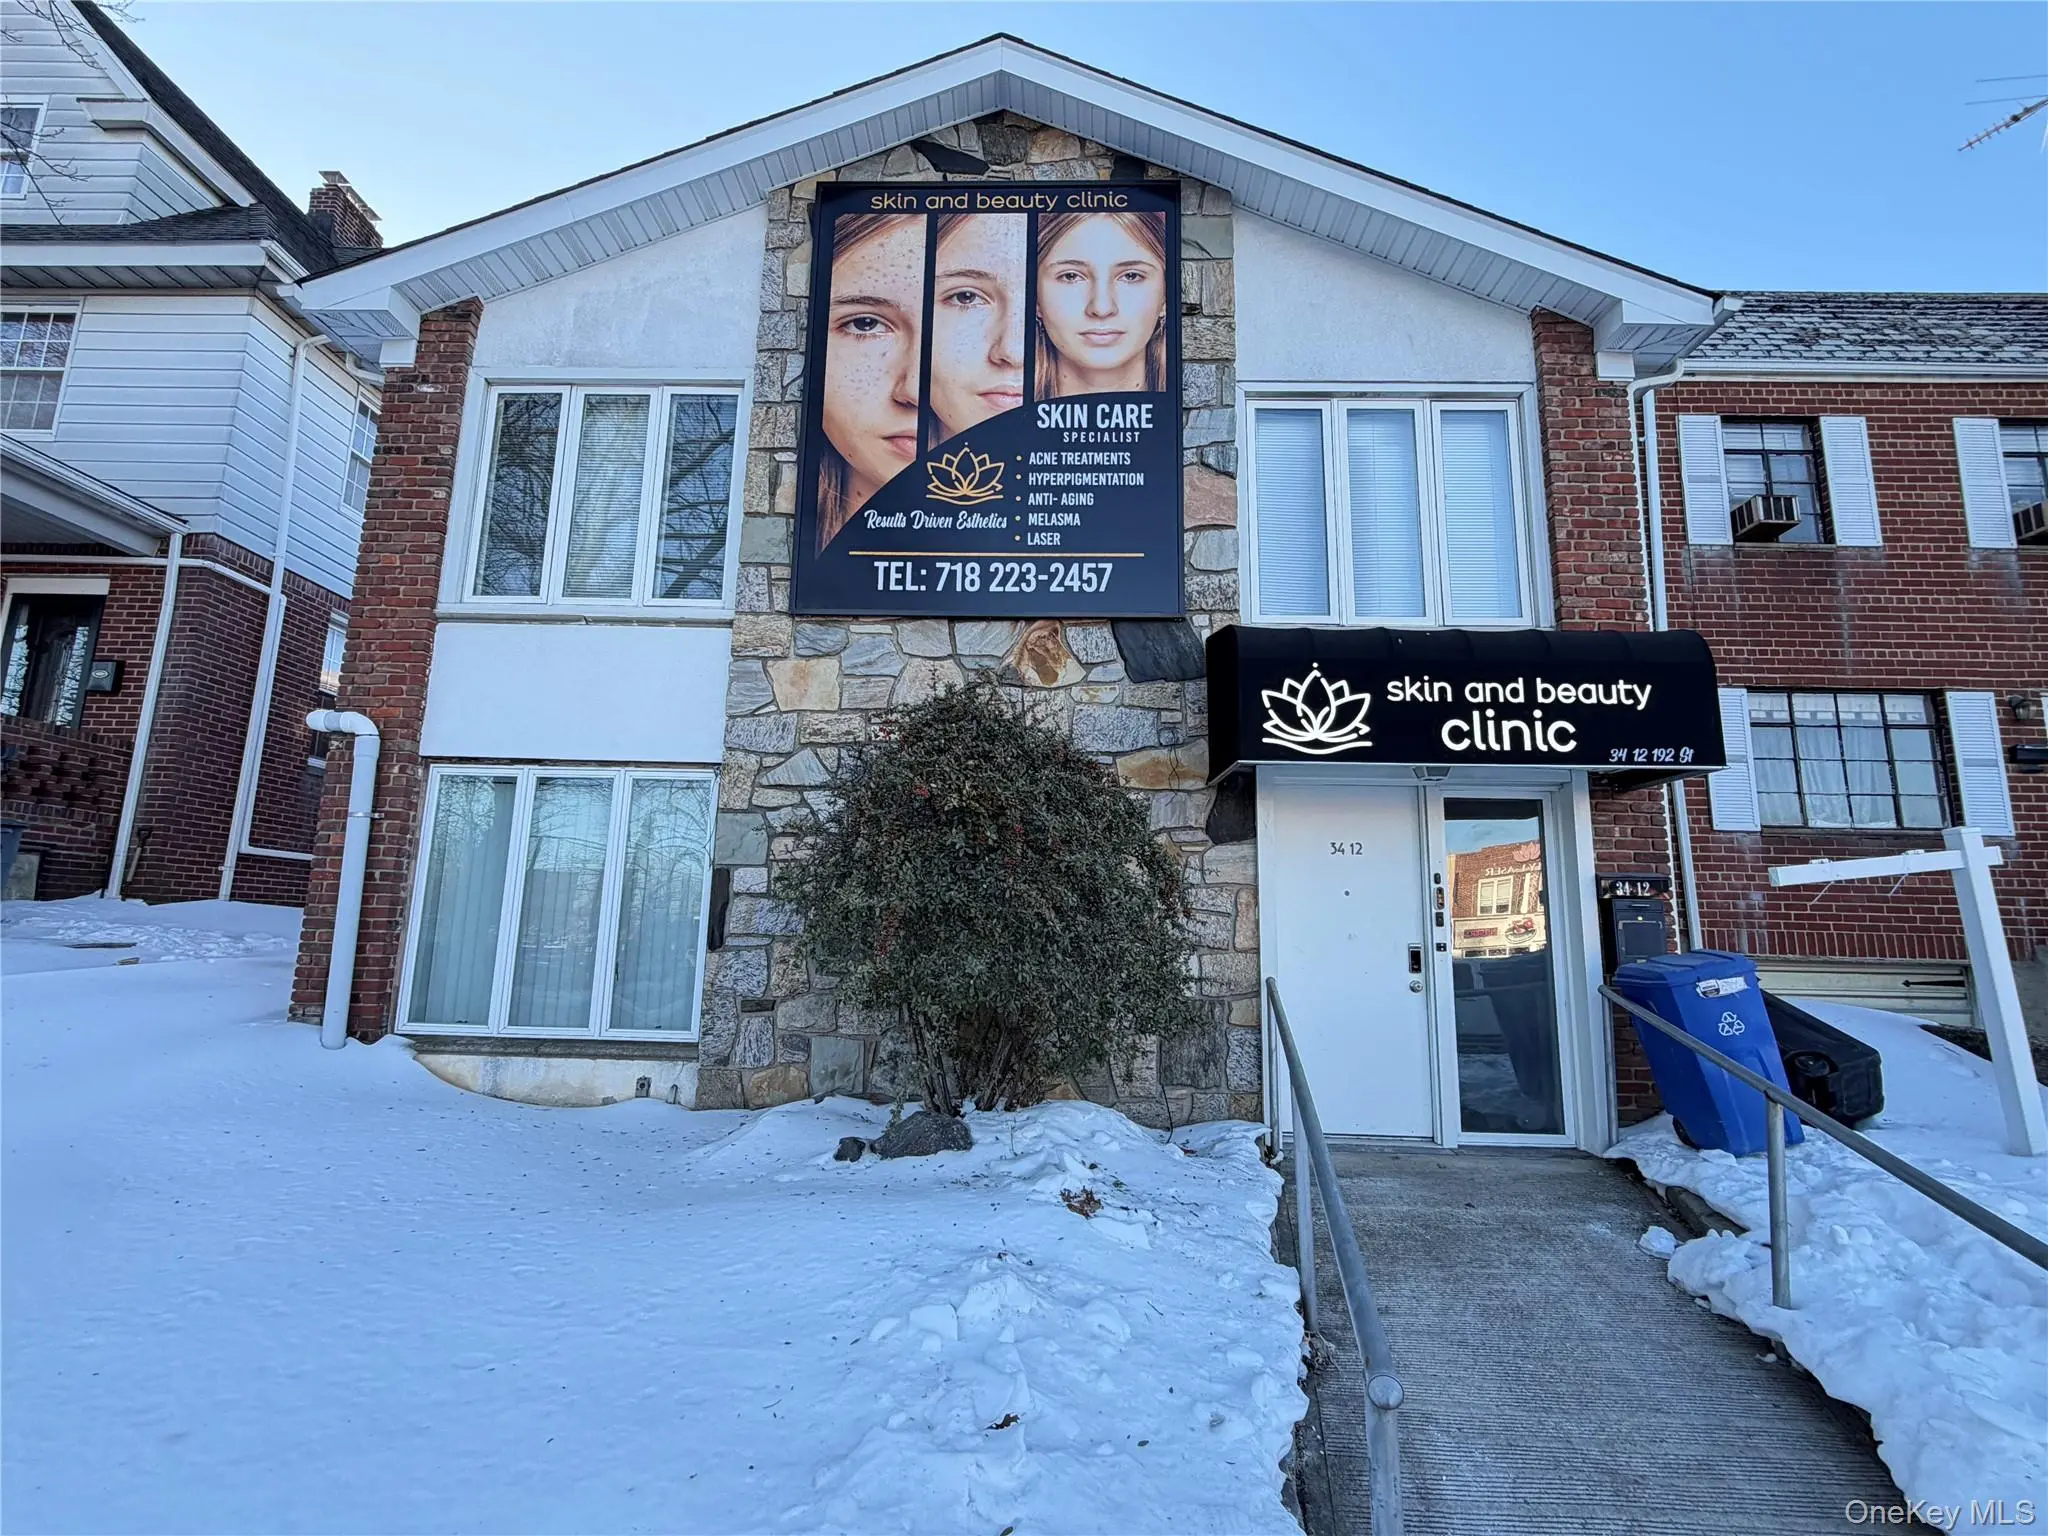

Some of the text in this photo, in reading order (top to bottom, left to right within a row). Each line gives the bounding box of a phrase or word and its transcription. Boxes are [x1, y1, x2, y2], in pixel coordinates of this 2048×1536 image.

[871, 191, 1128, 211] skin and beauty clinic
[1037, 404, 1153, 429] SKIN CARE
[1063, 432, 1140, 443] SPECIALIST
[1029, 452, 1131, 465] ACNE TREATMENTS
[1028, 472, 1144, 486] HYPERPIGMENTATION
[1028, 493, 1094, 506] ANTI- AGING
[864, 510, 1007, 530] Results Driven Esthetics
[1028, 513, 1081, 526] MELASMA
[1027, 532, 1061, 545] LASER
[874, 561, 1113, 593] TEL: 718 223-2457
[1387, 676, 1652, 711] skin and beauty
[1441, 708, 1577, 752] clinic
[1609, 748, 1628, 762] 34
[1632, 748, 1648, 762] 12
[1652, 748, 1675, 762] 192
[1330, 842, 1363, 855] 34 12
